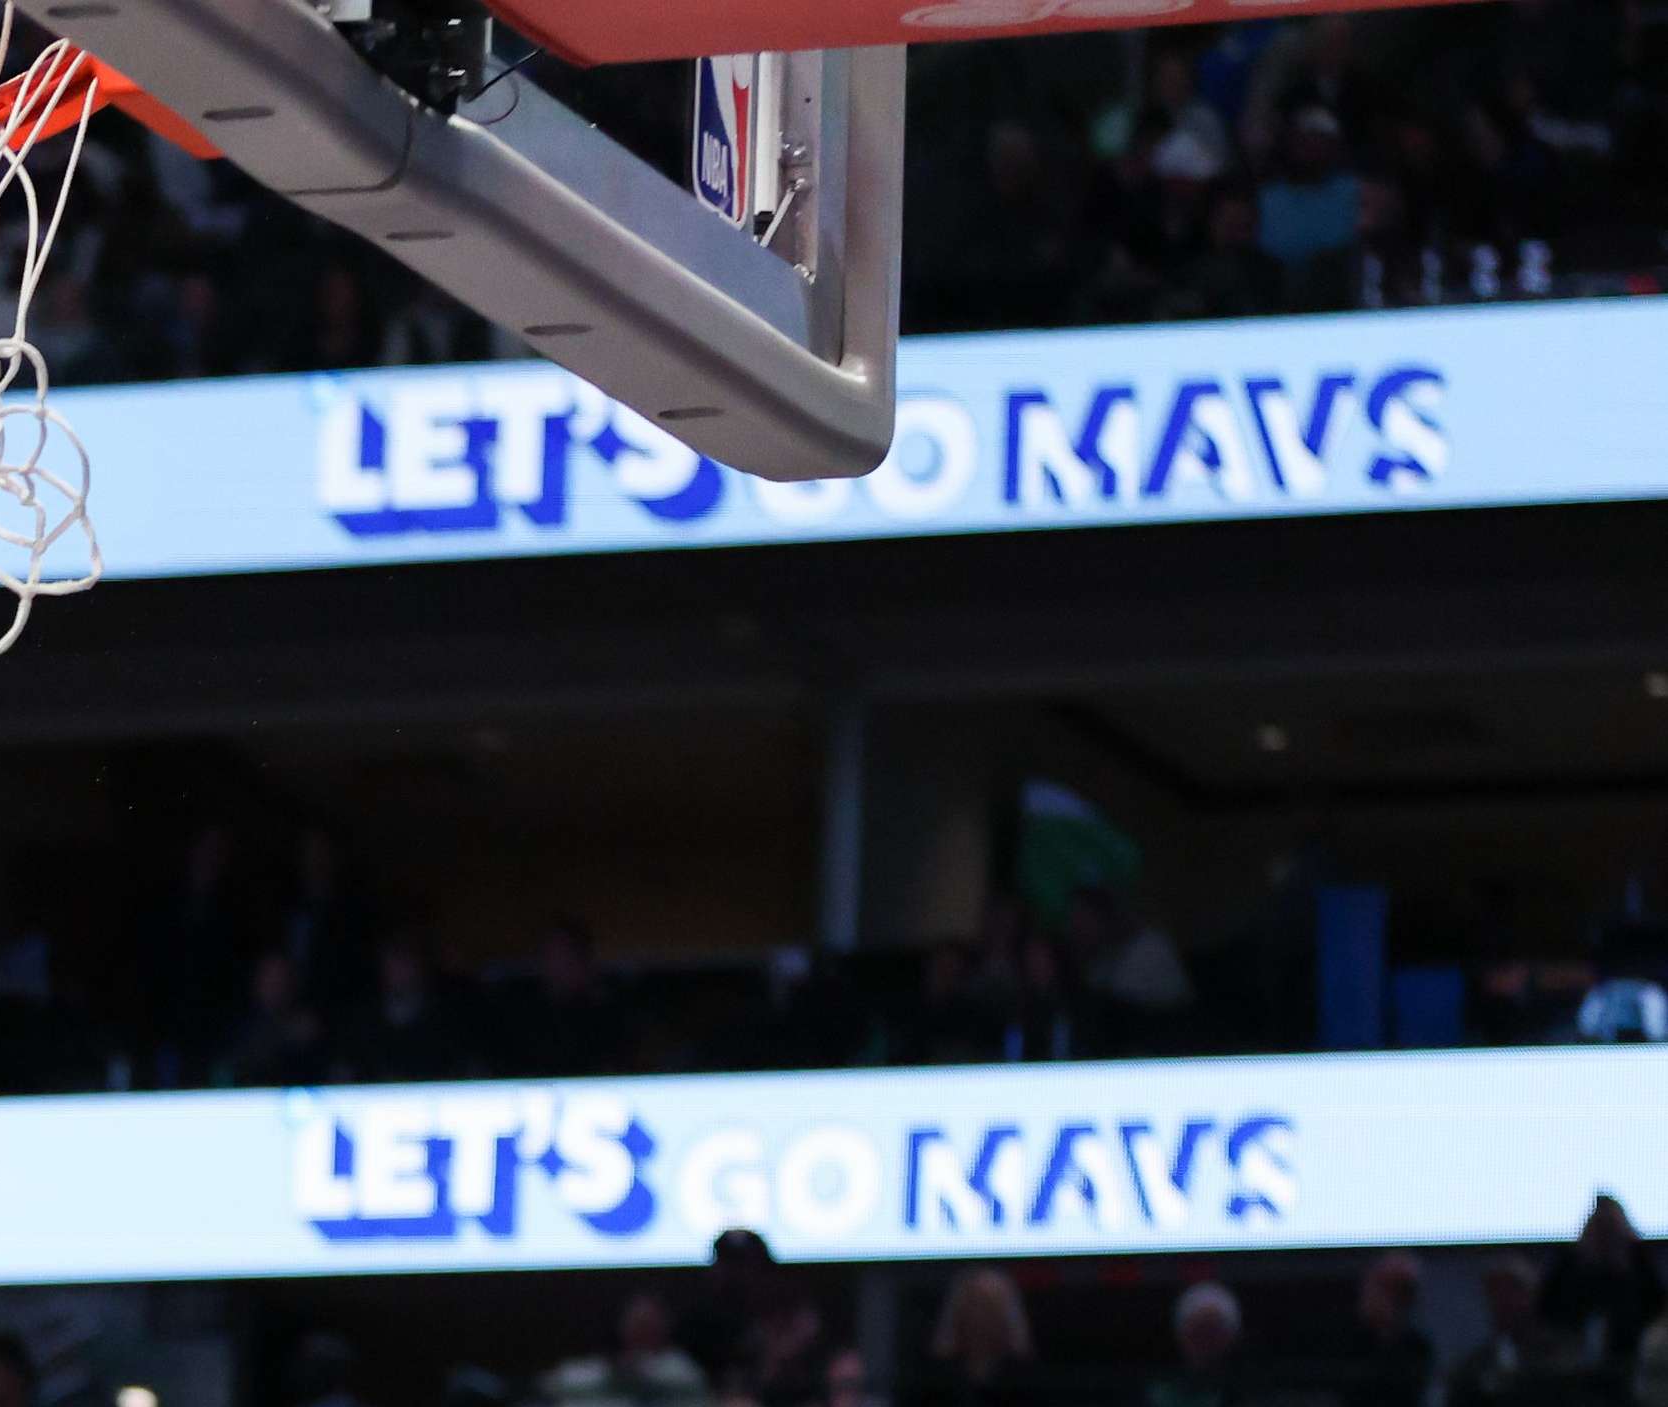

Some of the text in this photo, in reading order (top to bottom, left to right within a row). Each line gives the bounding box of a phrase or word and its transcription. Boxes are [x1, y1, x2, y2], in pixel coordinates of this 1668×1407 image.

[700, 130, 729, 199] NBA
[1001, 367, 1451, 506] MAVS
[291, 1088, 1298, 1243] LET'S GO MAVS
